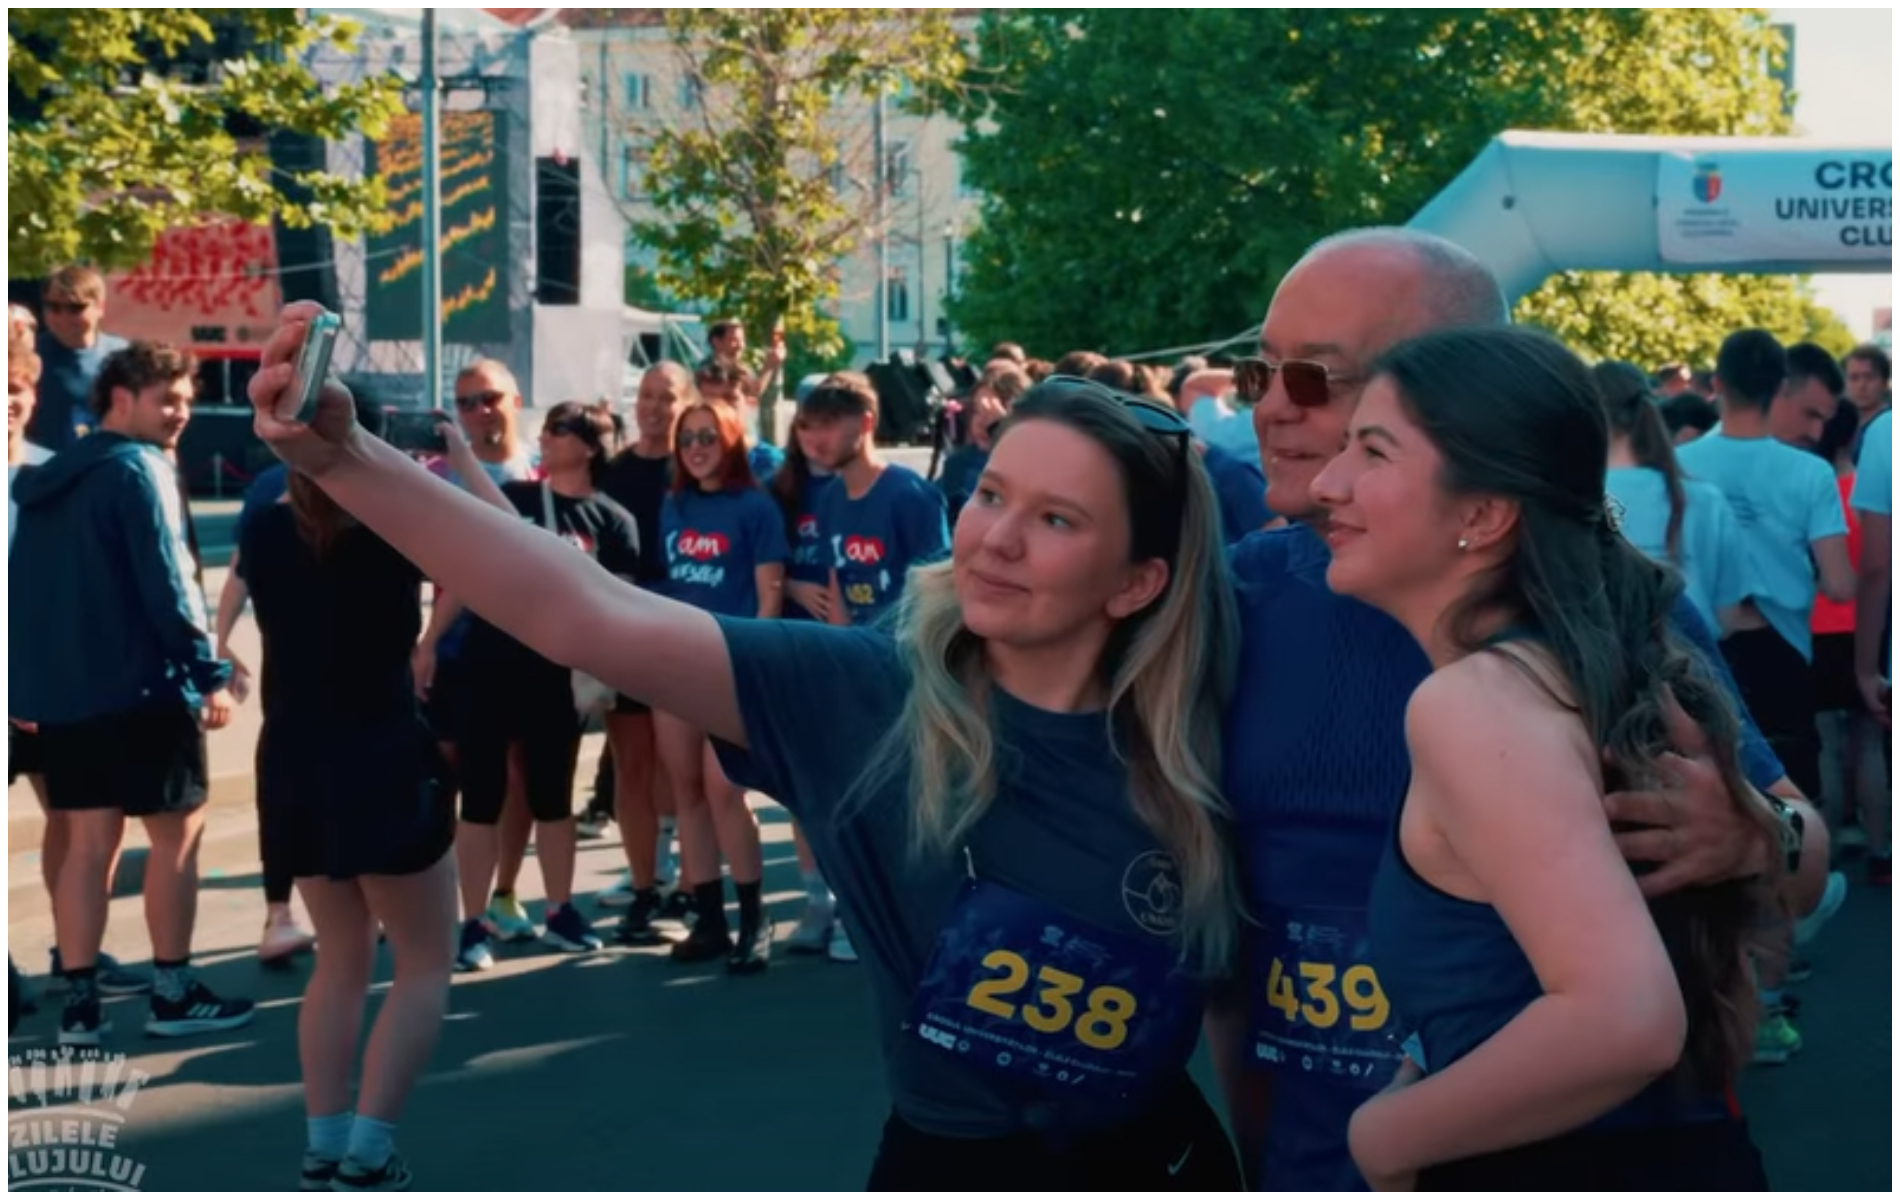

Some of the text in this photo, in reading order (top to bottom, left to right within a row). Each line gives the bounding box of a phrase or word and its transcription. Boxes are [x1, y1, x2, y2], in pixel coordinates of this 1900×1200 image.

[1775, 197, 1892, 220] UNIVER
[677, 535, 720, 558] am
[831, 534, 846, 568] I
[966, 949, 1138, 1051] 238
[1266, 956, 1391, 1031] 439
